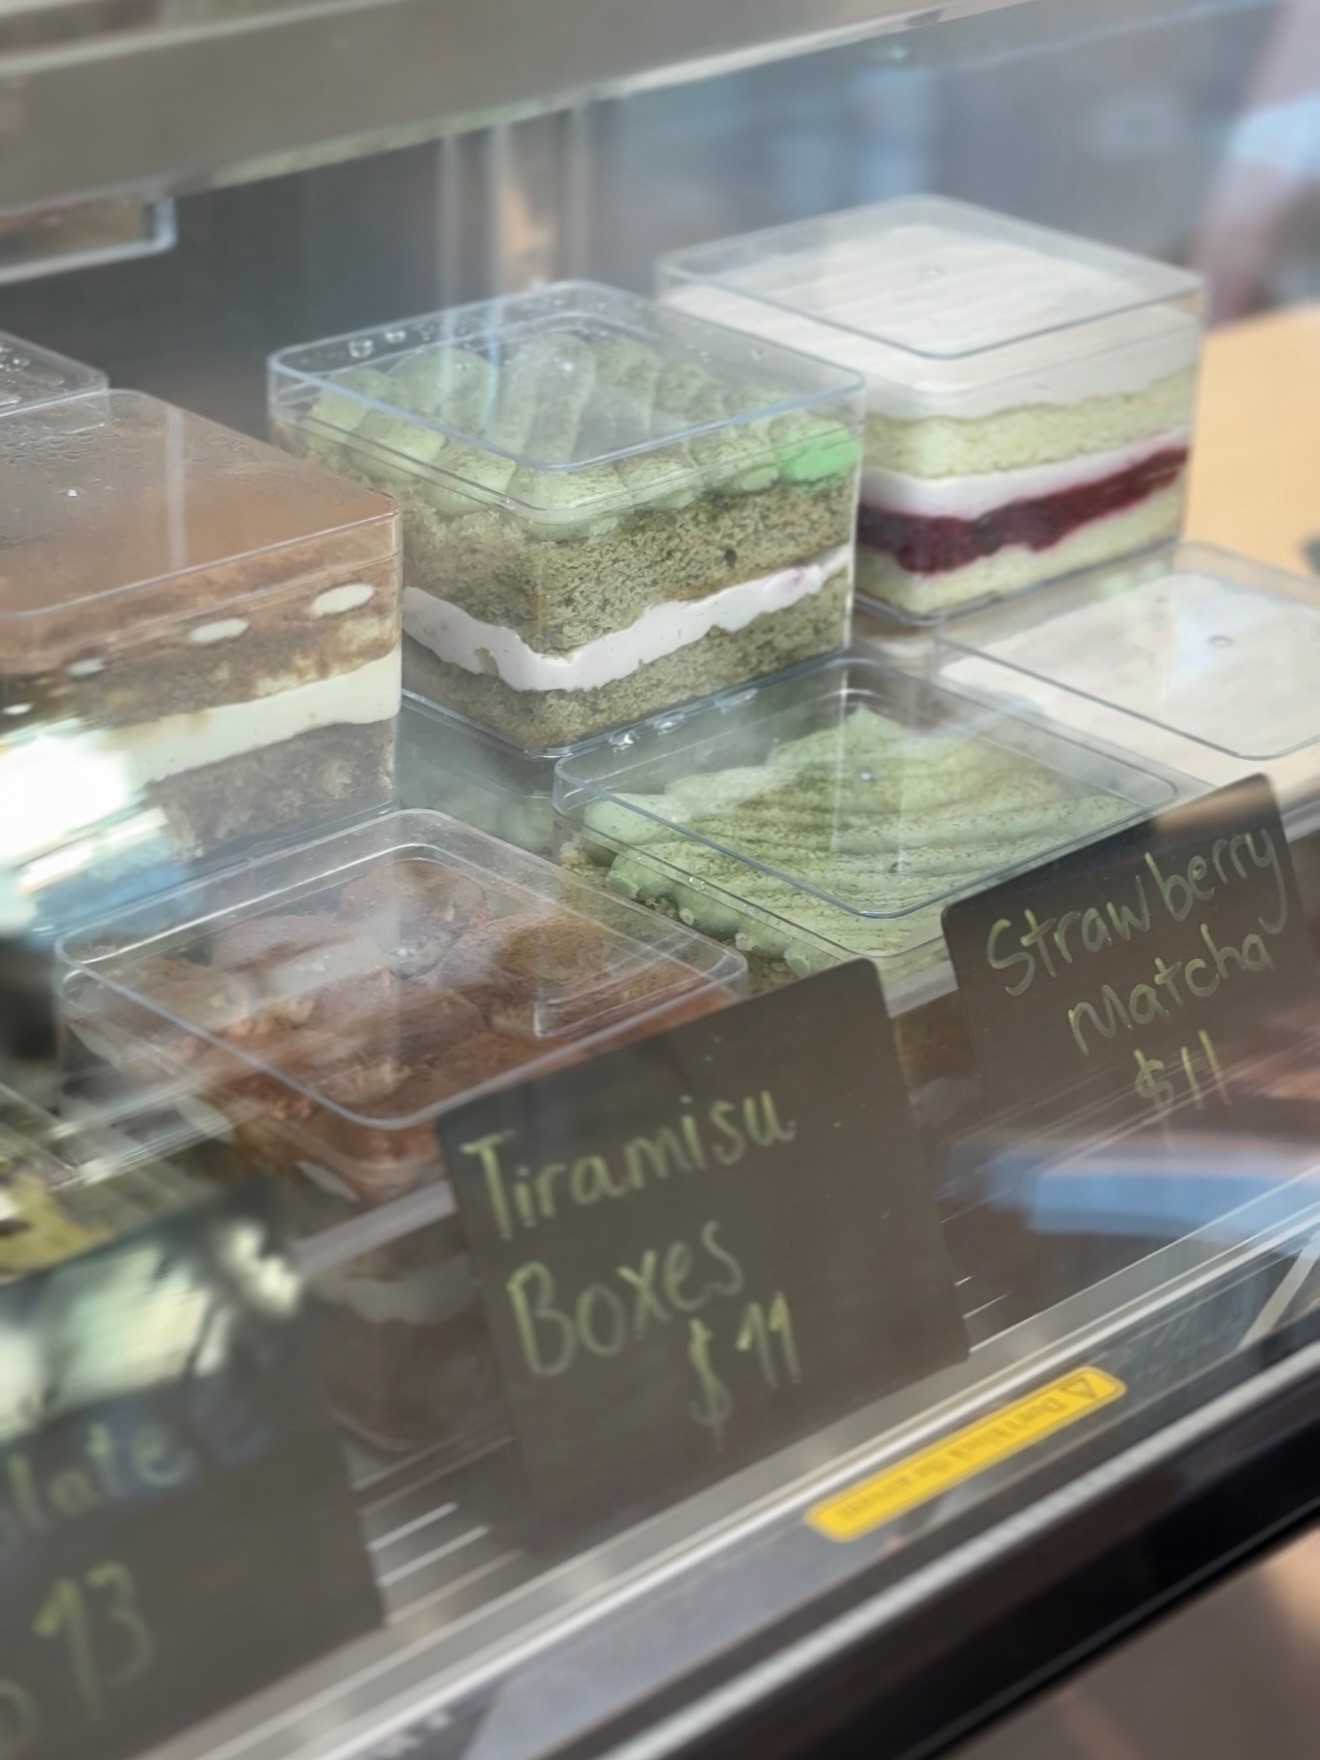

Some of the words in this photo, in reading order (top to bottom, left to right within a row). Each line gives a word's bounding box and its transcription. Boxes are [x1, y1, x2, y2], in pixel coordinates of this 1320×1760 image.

[986, 827, 1287, 997] Strawberry
[1067, 923, 1278, 1056] Matcha
[1132, 1028, 1232, 1148] $11
[460, 1090, 796, 1241] Tiramisu
[506, 1220, 744, 1378] Boxes
[688, 1290, 801, 1452] $11
[0, 1422, 197, 1562] late
